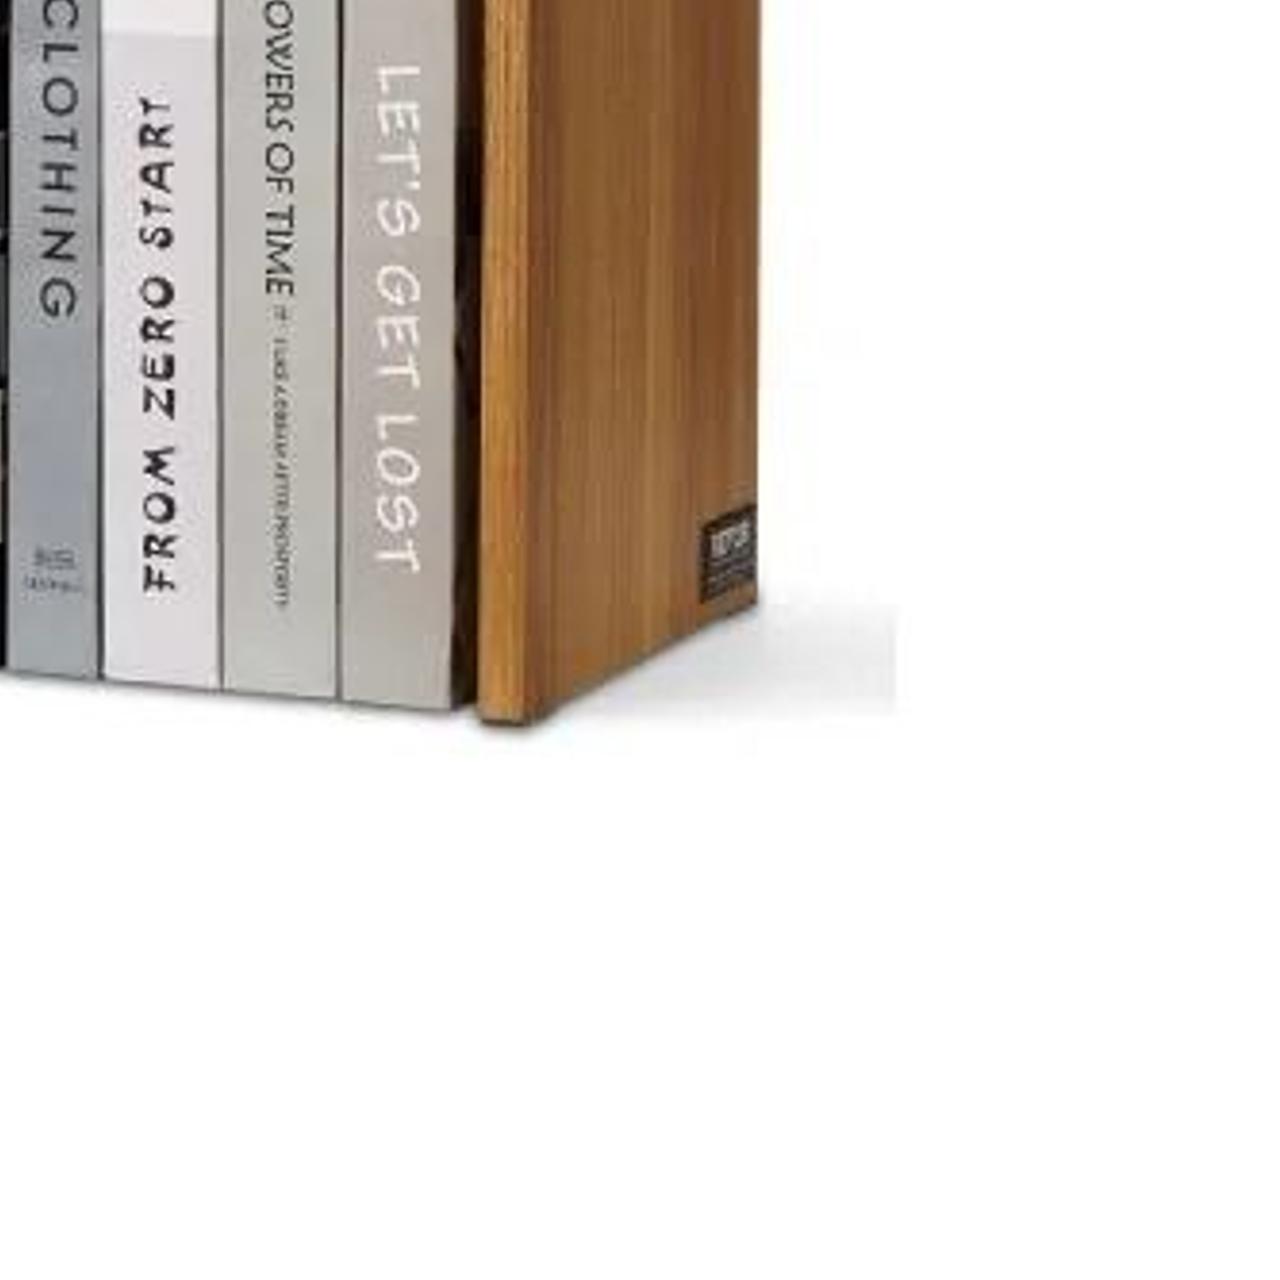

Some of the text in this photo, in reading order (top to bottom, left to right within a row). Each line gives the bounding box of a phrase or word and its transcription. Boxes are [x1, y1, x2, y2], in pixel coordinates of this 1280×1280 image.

[266, 142, 294, 202] OF
[266, 207, 295, 296] TIME
[376, 64, 421, 572] LET'S GET LOST
[138, 96, 176, 594] FROM ZERO START
